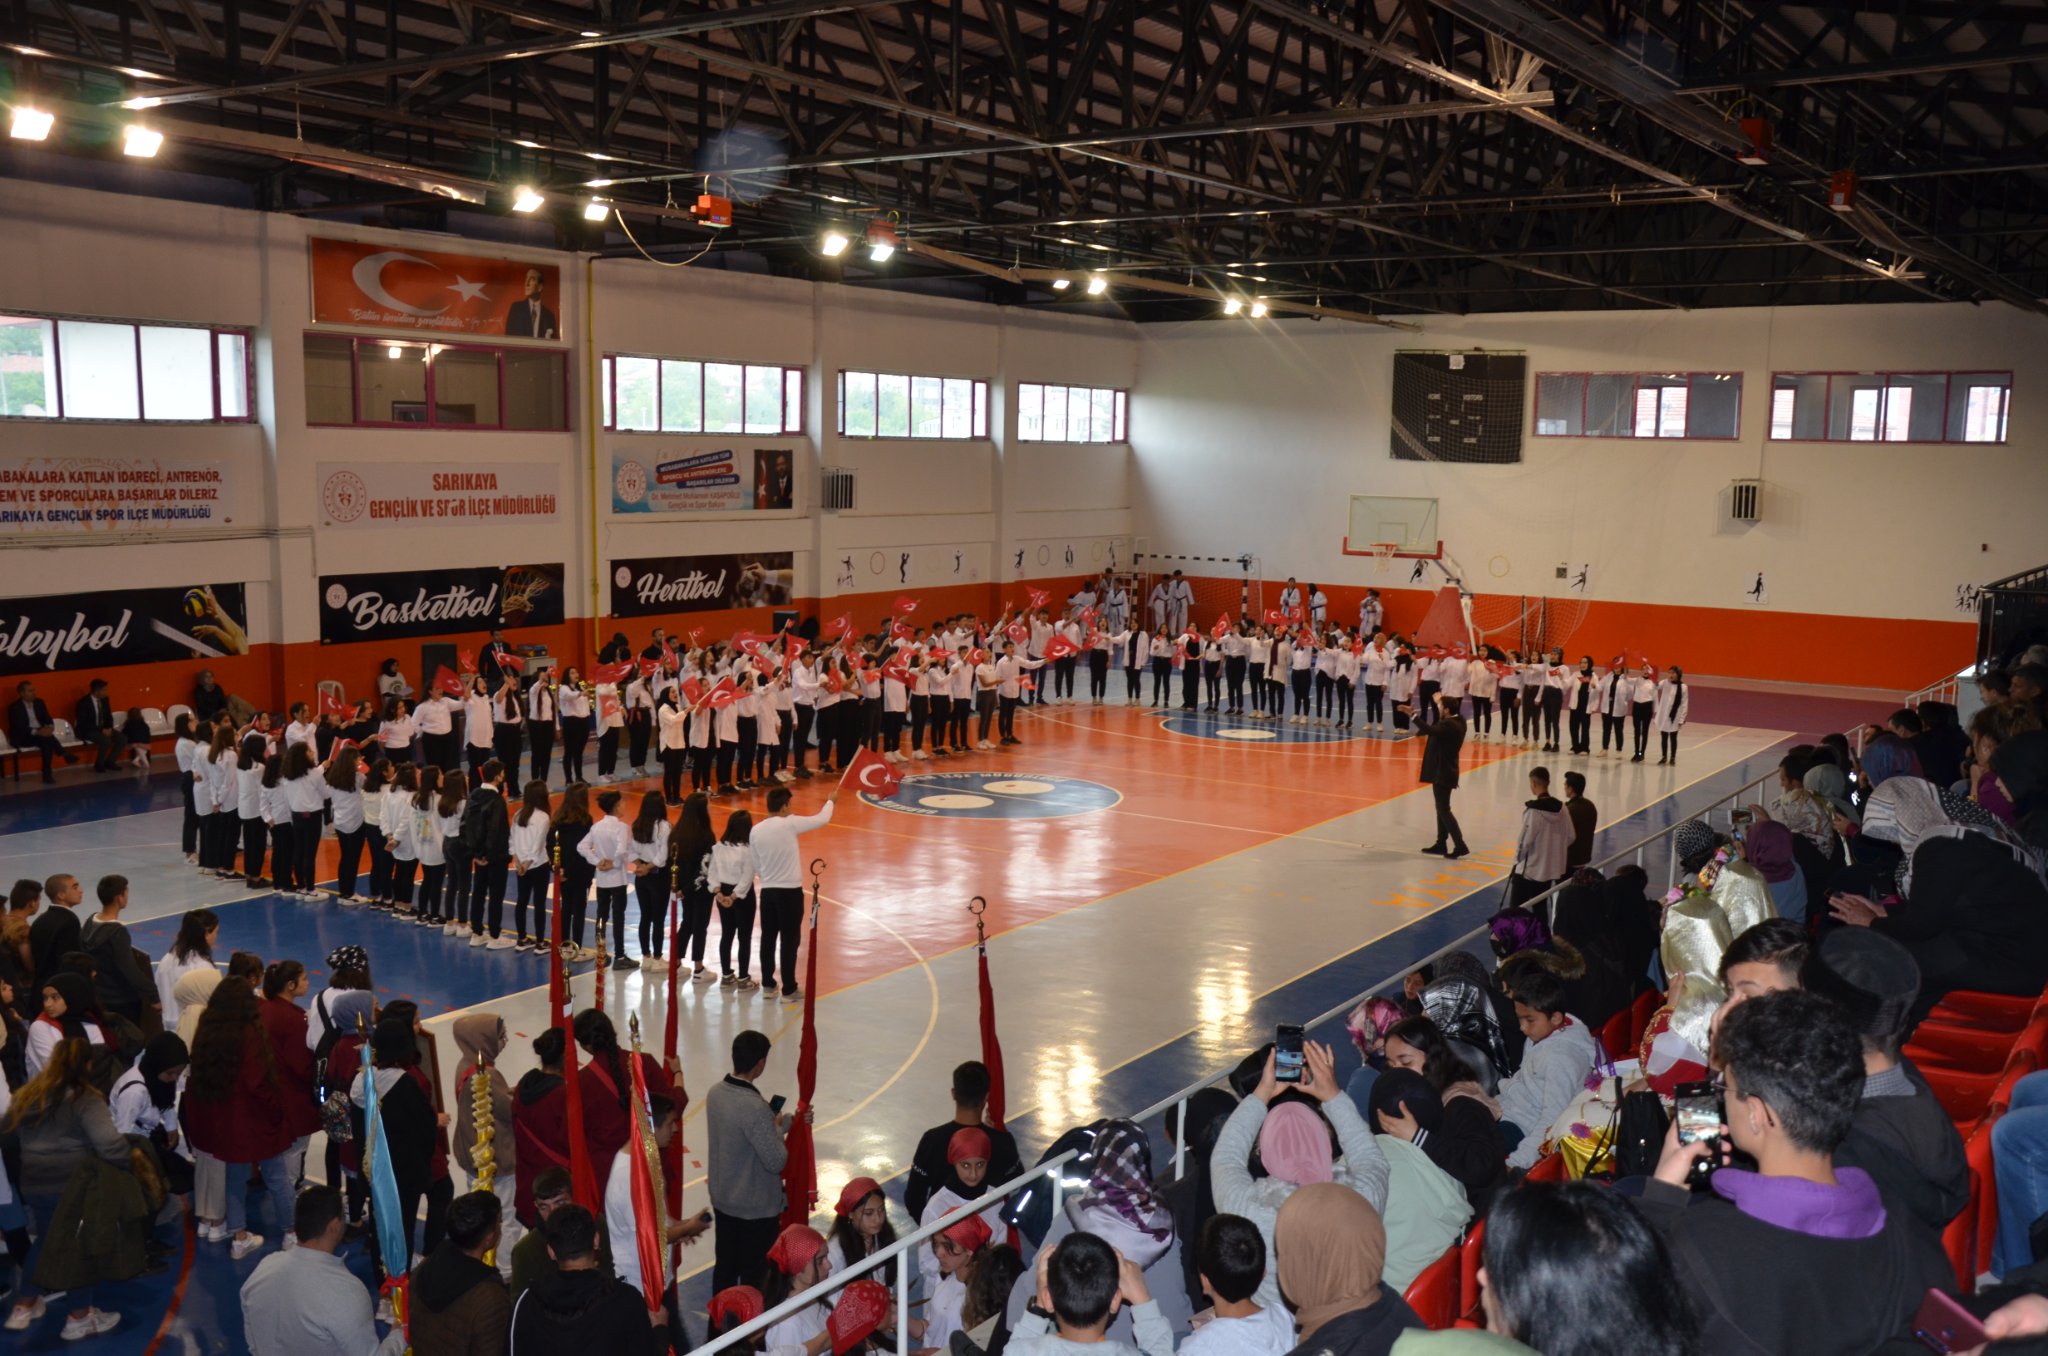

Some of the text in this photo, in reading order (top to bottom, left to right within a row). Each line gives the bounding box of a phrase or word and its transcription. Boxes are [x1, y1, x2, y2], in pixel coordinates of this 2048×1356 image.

[69, 471, 114, 483] KATILAN
[166, 468, 222, 485] ANTRENÖR,
[432, 473, 498, 491] SARIKAYA
[21, 490, 35, 502] VE
[40, 490, 114, 502] SPORCULARA
[118, 489, 176, 503] BAŞARILAR
[47, 507, 93, 524] GENÇLİK
[96, 510, 124, 521] SPOR
[127, 506, 149, 522] İLÇE
[152, 505, 211, 520] MÜDÜRLÜĞÜ
[369, 497, 418, 521] GENÇLİK
[420, 499, 434, 517] VE
[468, 495, 491, 519] İLÇE
[493, 494, 556, 516] MÜDÜRLÜĞÜ
[636, 569, 726, 605] Hentbol
[347, 583, 499, 631] Basketbol
